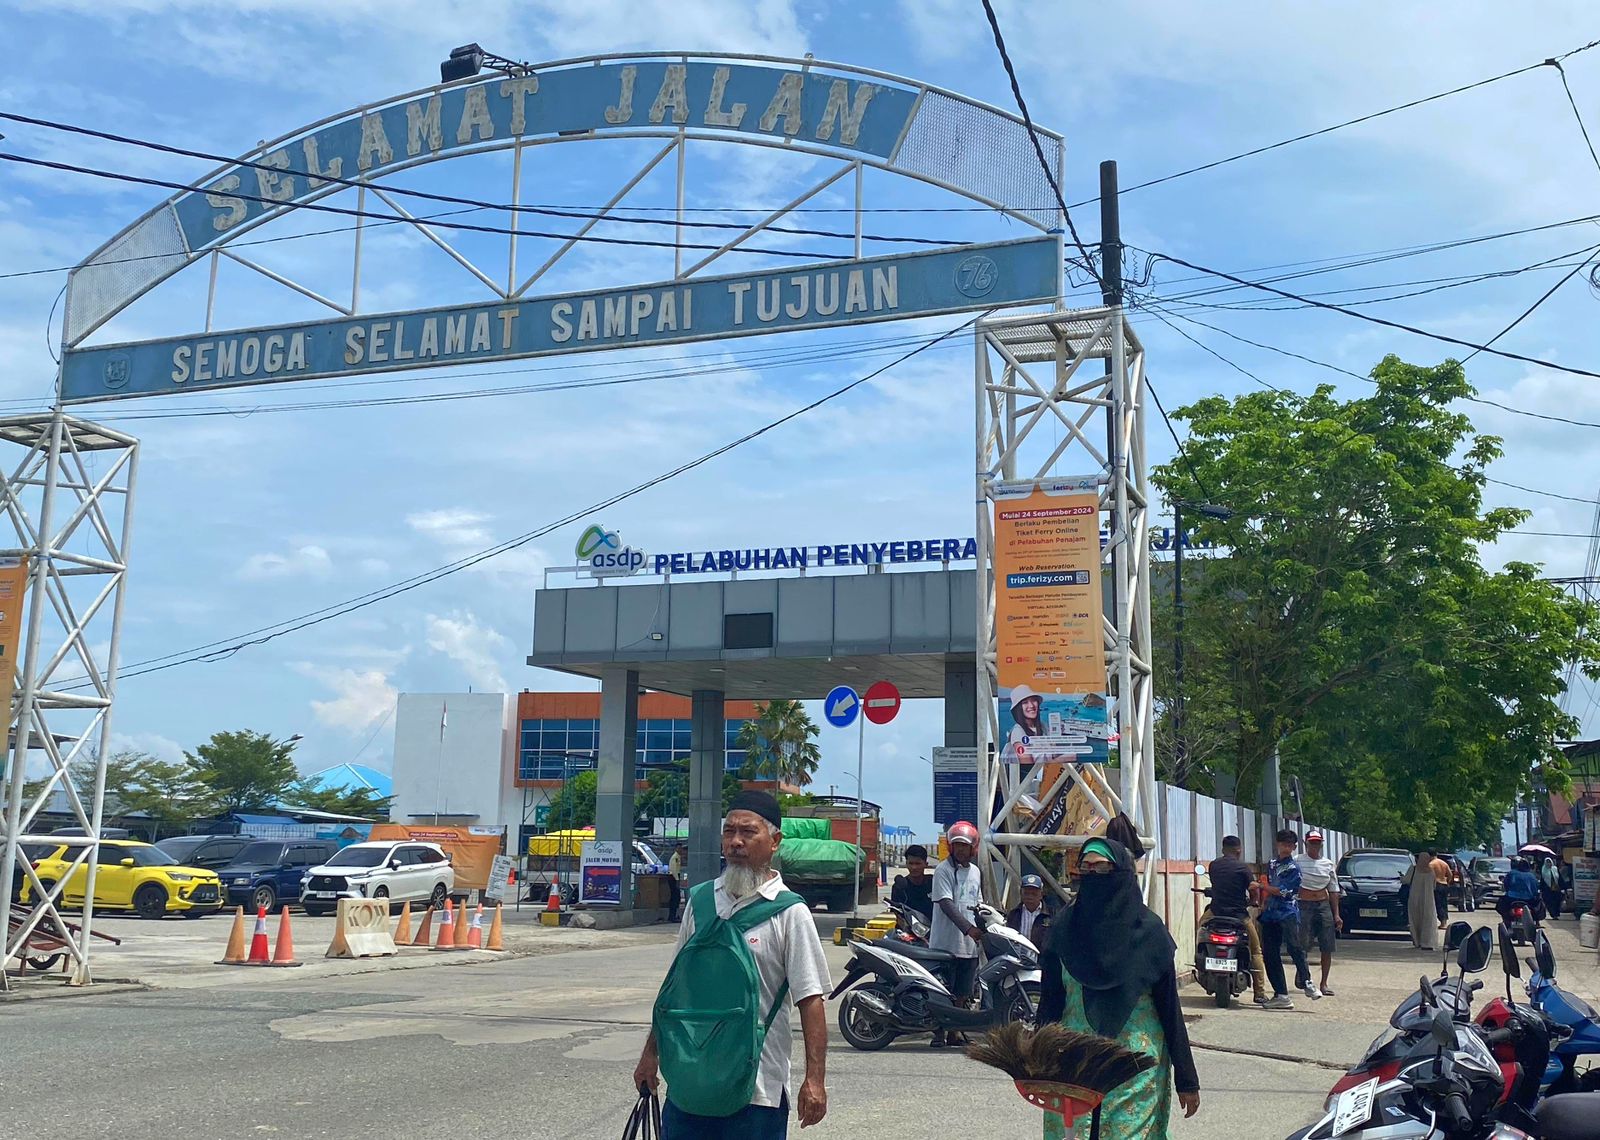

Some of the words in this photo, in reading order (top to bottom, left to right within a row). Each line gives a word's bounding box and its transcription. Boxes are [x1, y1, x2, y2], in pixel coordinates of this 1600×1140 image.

[205, 76, 540, 232] SELAMAT
[604, 63, 877, 147] JALAN
[171, 331, 307, 384] SEMOGA
[344, 307, 520, 366] SELAMAT
[550, 288, 693, 343] SAMPAI
[727, 266, 899, 325] TUJUAN
[1032, 508, 1071, 517] September
[1017, 537, 1054, 545] Pelabuhan
[1055, 536, 1086, 544] Penajam
[592, 544, 644, 572] asdp
[655, 547, 808, 575] PELABUHAN
[1010, 574, 1073, 584] trip.ferizy.com
